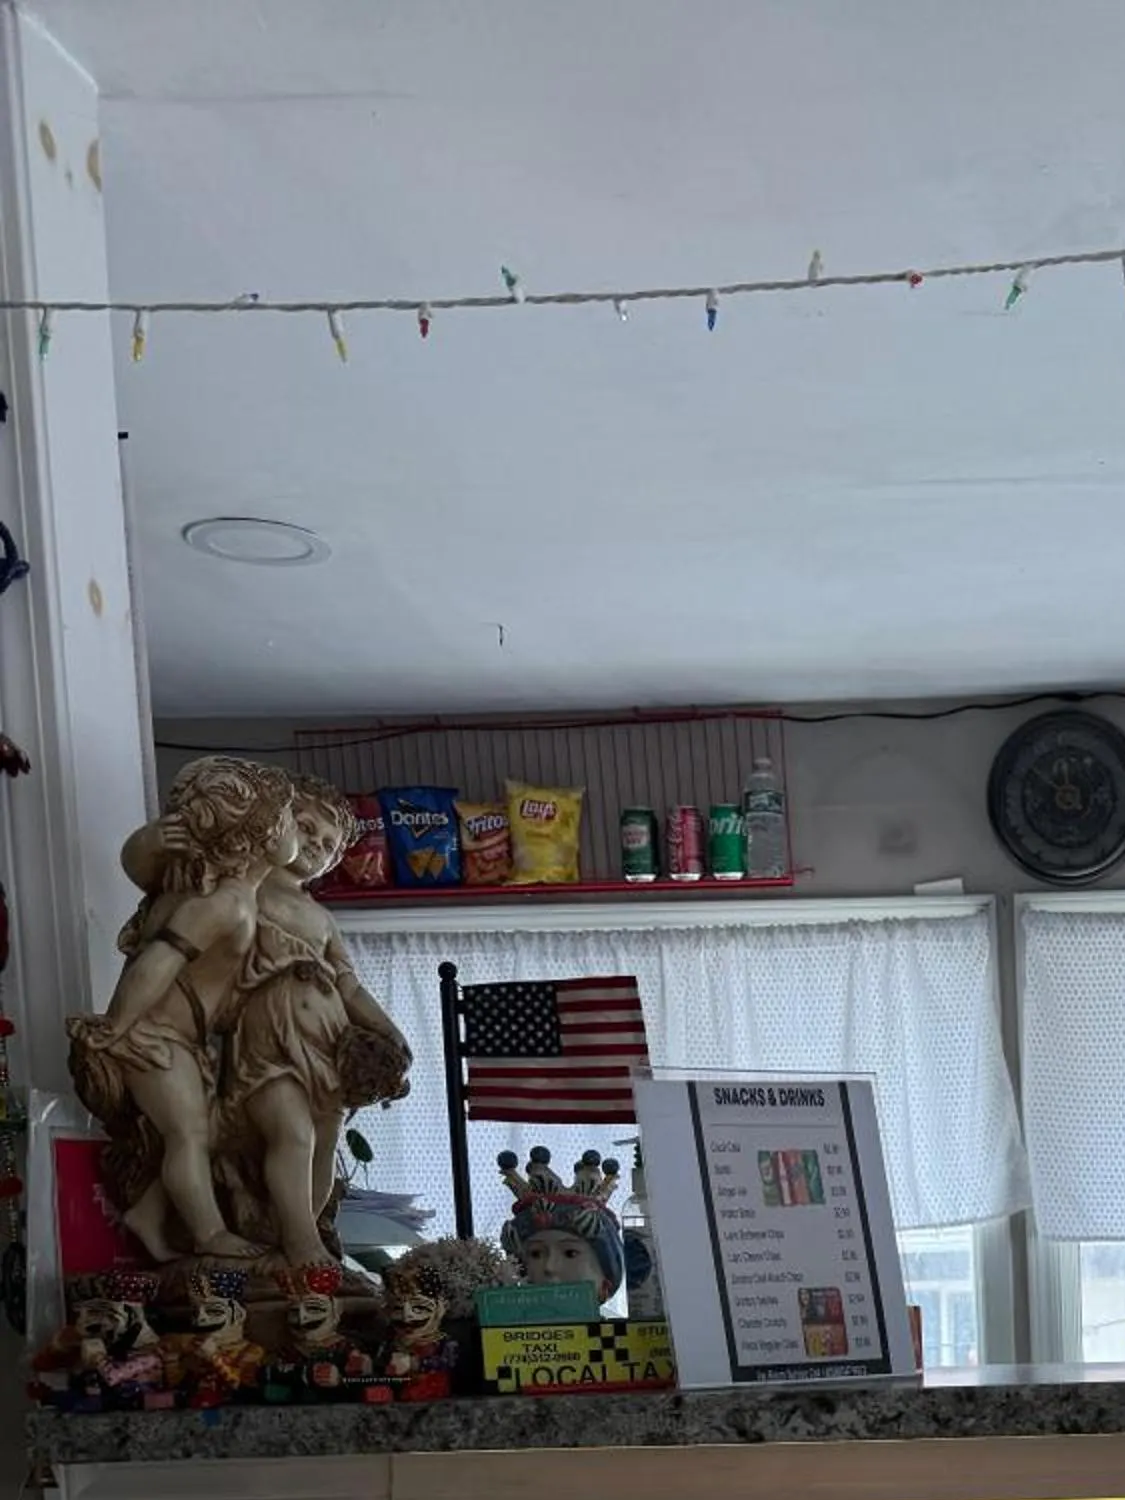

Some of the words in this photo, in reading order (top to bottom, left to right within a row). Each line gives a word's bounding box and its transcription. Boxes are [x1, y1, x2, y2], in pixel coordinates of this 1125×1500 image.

[391, 810, 450, 825] Doritos
[714, 1087, 767, 1106] SNACKS
[768, 1088, 777, 1106] &
[778, 1088, 826, 1107] DRINKS
[503, 1329, 575, 1342] BRIDGES
[521, 1343, 558, 1353] TAXI
